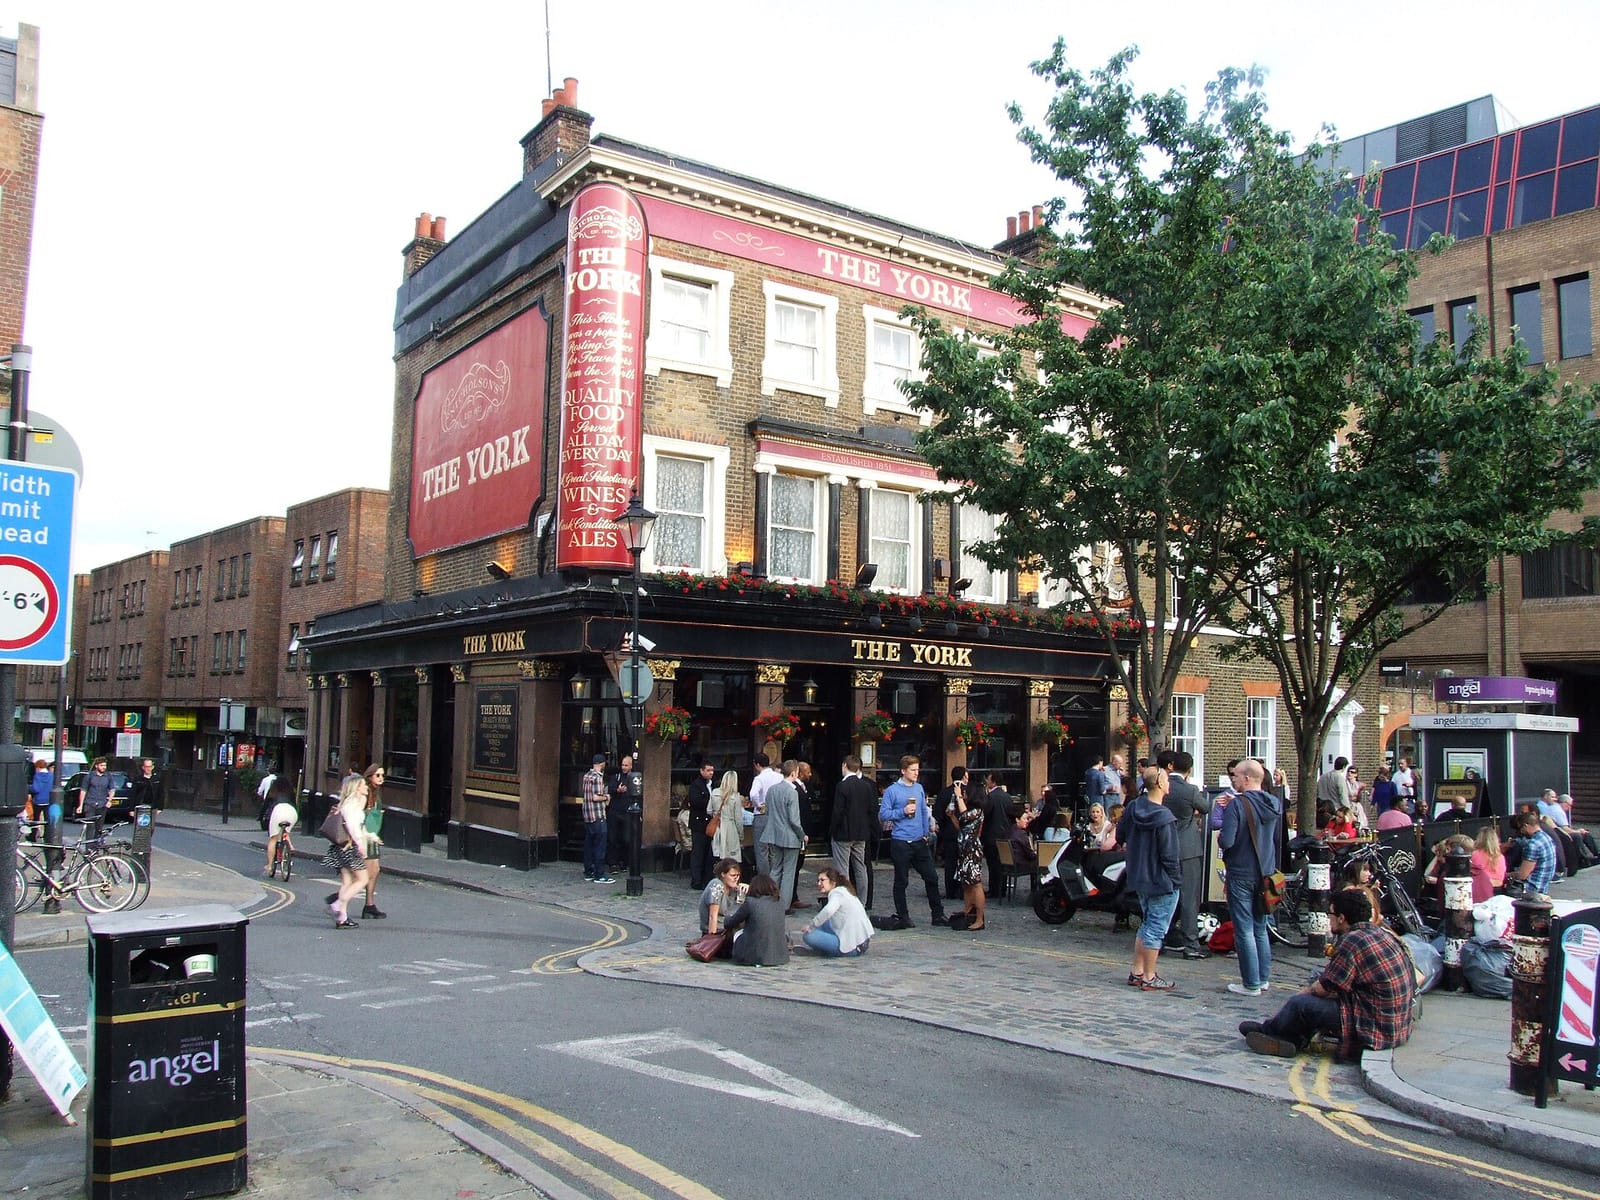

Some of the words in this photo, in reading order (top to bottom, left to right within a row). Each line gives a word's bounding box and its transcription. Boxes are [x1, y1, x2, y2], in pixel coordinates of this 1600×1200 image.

[579, 247, 626, 267] THE
[568, 268, 641, 297] YORK
[817, 247, 881, 288] THE
[889, 267, 973, 313] YORK
[568, 312, 592, 328] This
[584, 329, 593, 337] a
[584, 364, 601, 377] the
[563, 387, 635, 407] QUALITY
[570, 404, 625, 422] FOOD
[567, 434, 592, 449] ALL
[595, 434, 627, 448] DAY
[422, 456, 461, 503] THE
[466, 425, 530, 486] YORK
[561, 447, 602, 463] EVERY
[606, 448, 633, 463] DAY
[821, 452, 873, 468] ESTABLISHED
[875, 462, 892, 472] 1851
[0, 471, 51, 497] idth
[564, 486, 626, 504] WINES
[1, 499, 42, 520] mit
[587, 503, 599, 516] &
[0, 526, 49, 545] ead
[568, 531, 618, 548] ALES
[463, 634, 487, 655] THE
[491, 630, 526, 653] YORK
[851, 639, 901, 662] THE
[910, 643, 973, 667] YORK
[1448, 680, 1481, 698] angel
[480, 704, 493, 715] THE
[493, 704, 512, 715] YORK
[128, 1039, 220, 1087] angel
